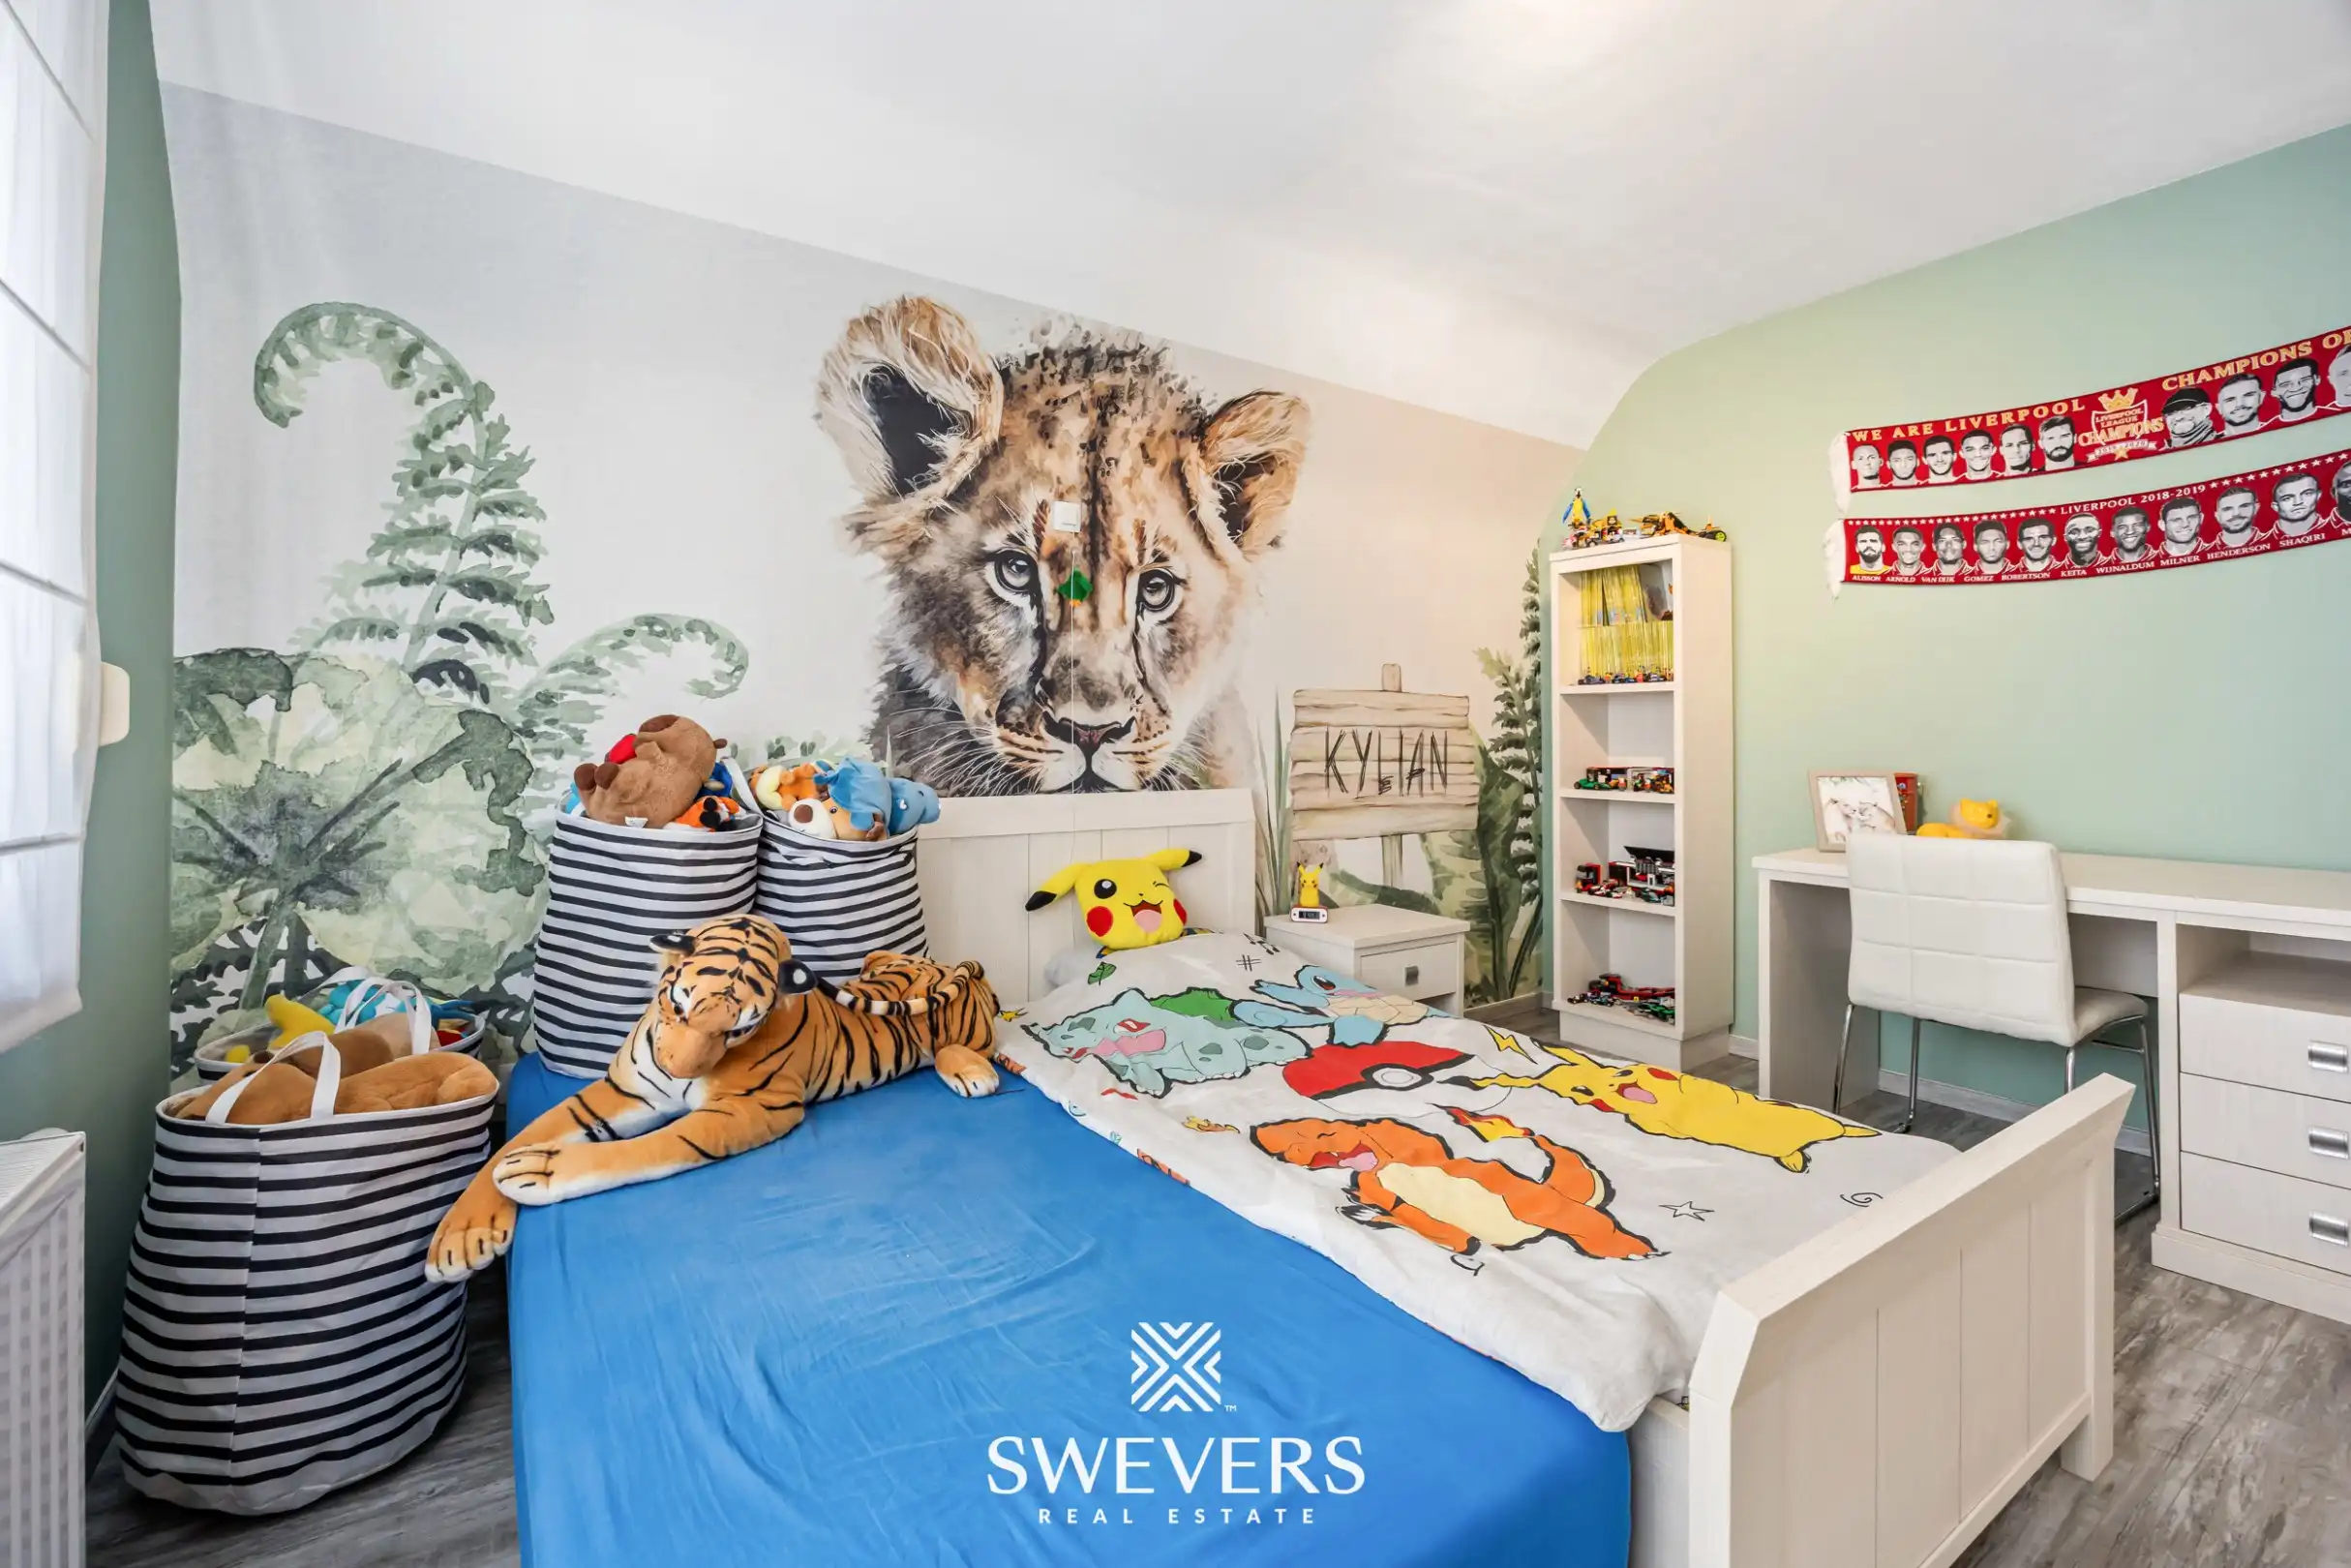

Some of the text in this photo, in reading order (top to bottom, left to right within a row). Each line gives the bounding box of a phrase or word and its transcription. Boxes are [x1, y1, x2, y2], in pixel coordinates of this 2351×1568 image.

[2162, 340, 2313, 391] CHAMPIONS
[1853, 399, 2085, 442] WE ARE LIVERPOOL
[2077, 416, 2165, 447] CHAMPIONS
[2061, 484, 2207, 515] LIVERPOOL 2018-2019
[2159, 555, 2200, 567] MILNER
[2206, 543, 2272, 560] HENDERSON
[2279, 532, 2326, 548] SHAQIRI
[1325, 725, 1449, 799] KYLIAN
